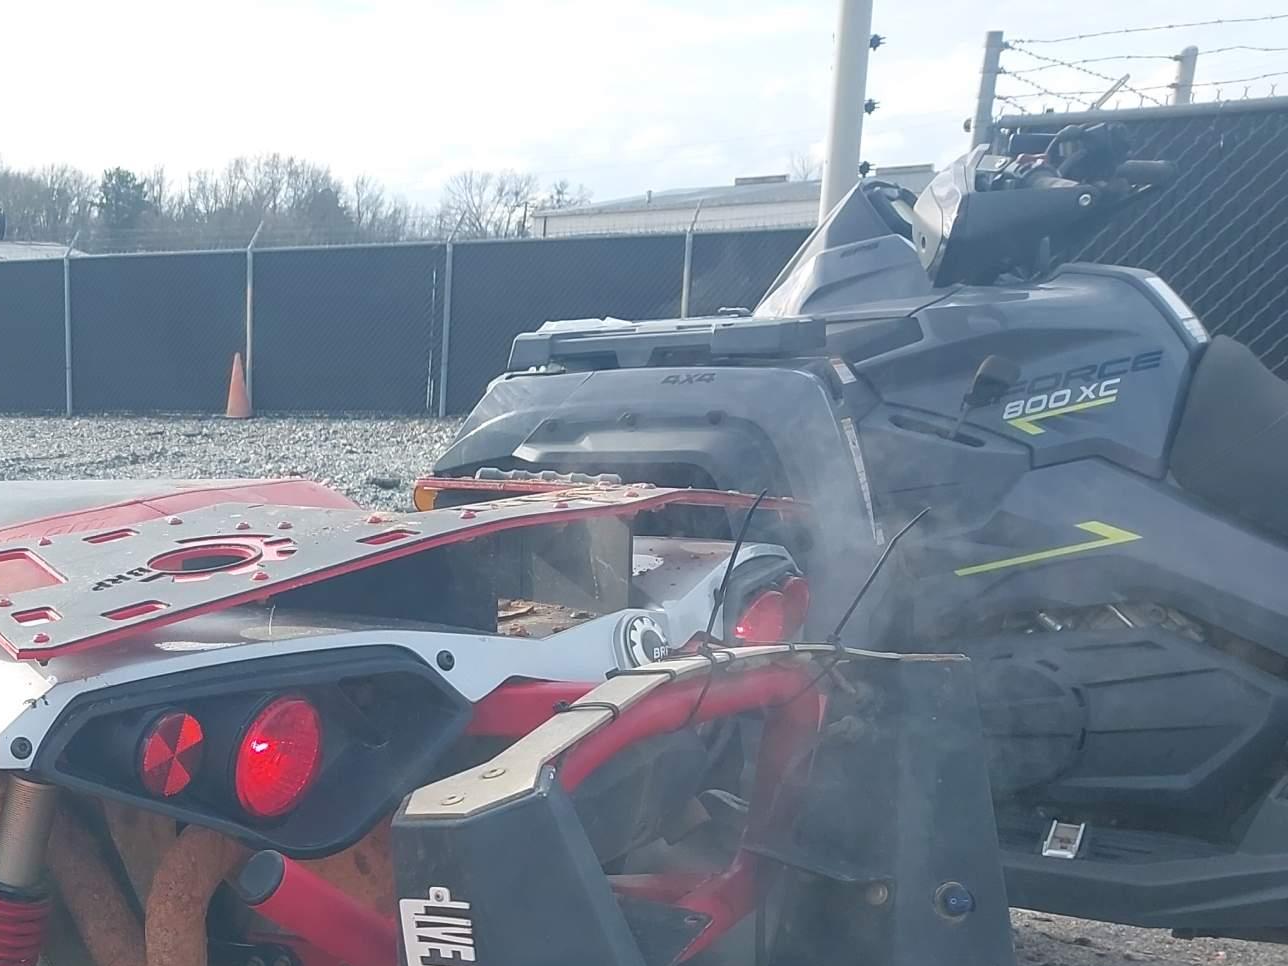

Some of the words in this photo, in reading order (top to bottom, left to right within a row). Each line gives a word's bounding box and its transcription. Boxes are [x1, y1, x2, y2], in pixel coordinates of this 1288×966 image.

[660, 372, 716, 385] 4X4
[1002, 388, 1072, 420] 800
[1076, 377, 1121, 402] XC
[413, 900, 476, 963] LIVE
